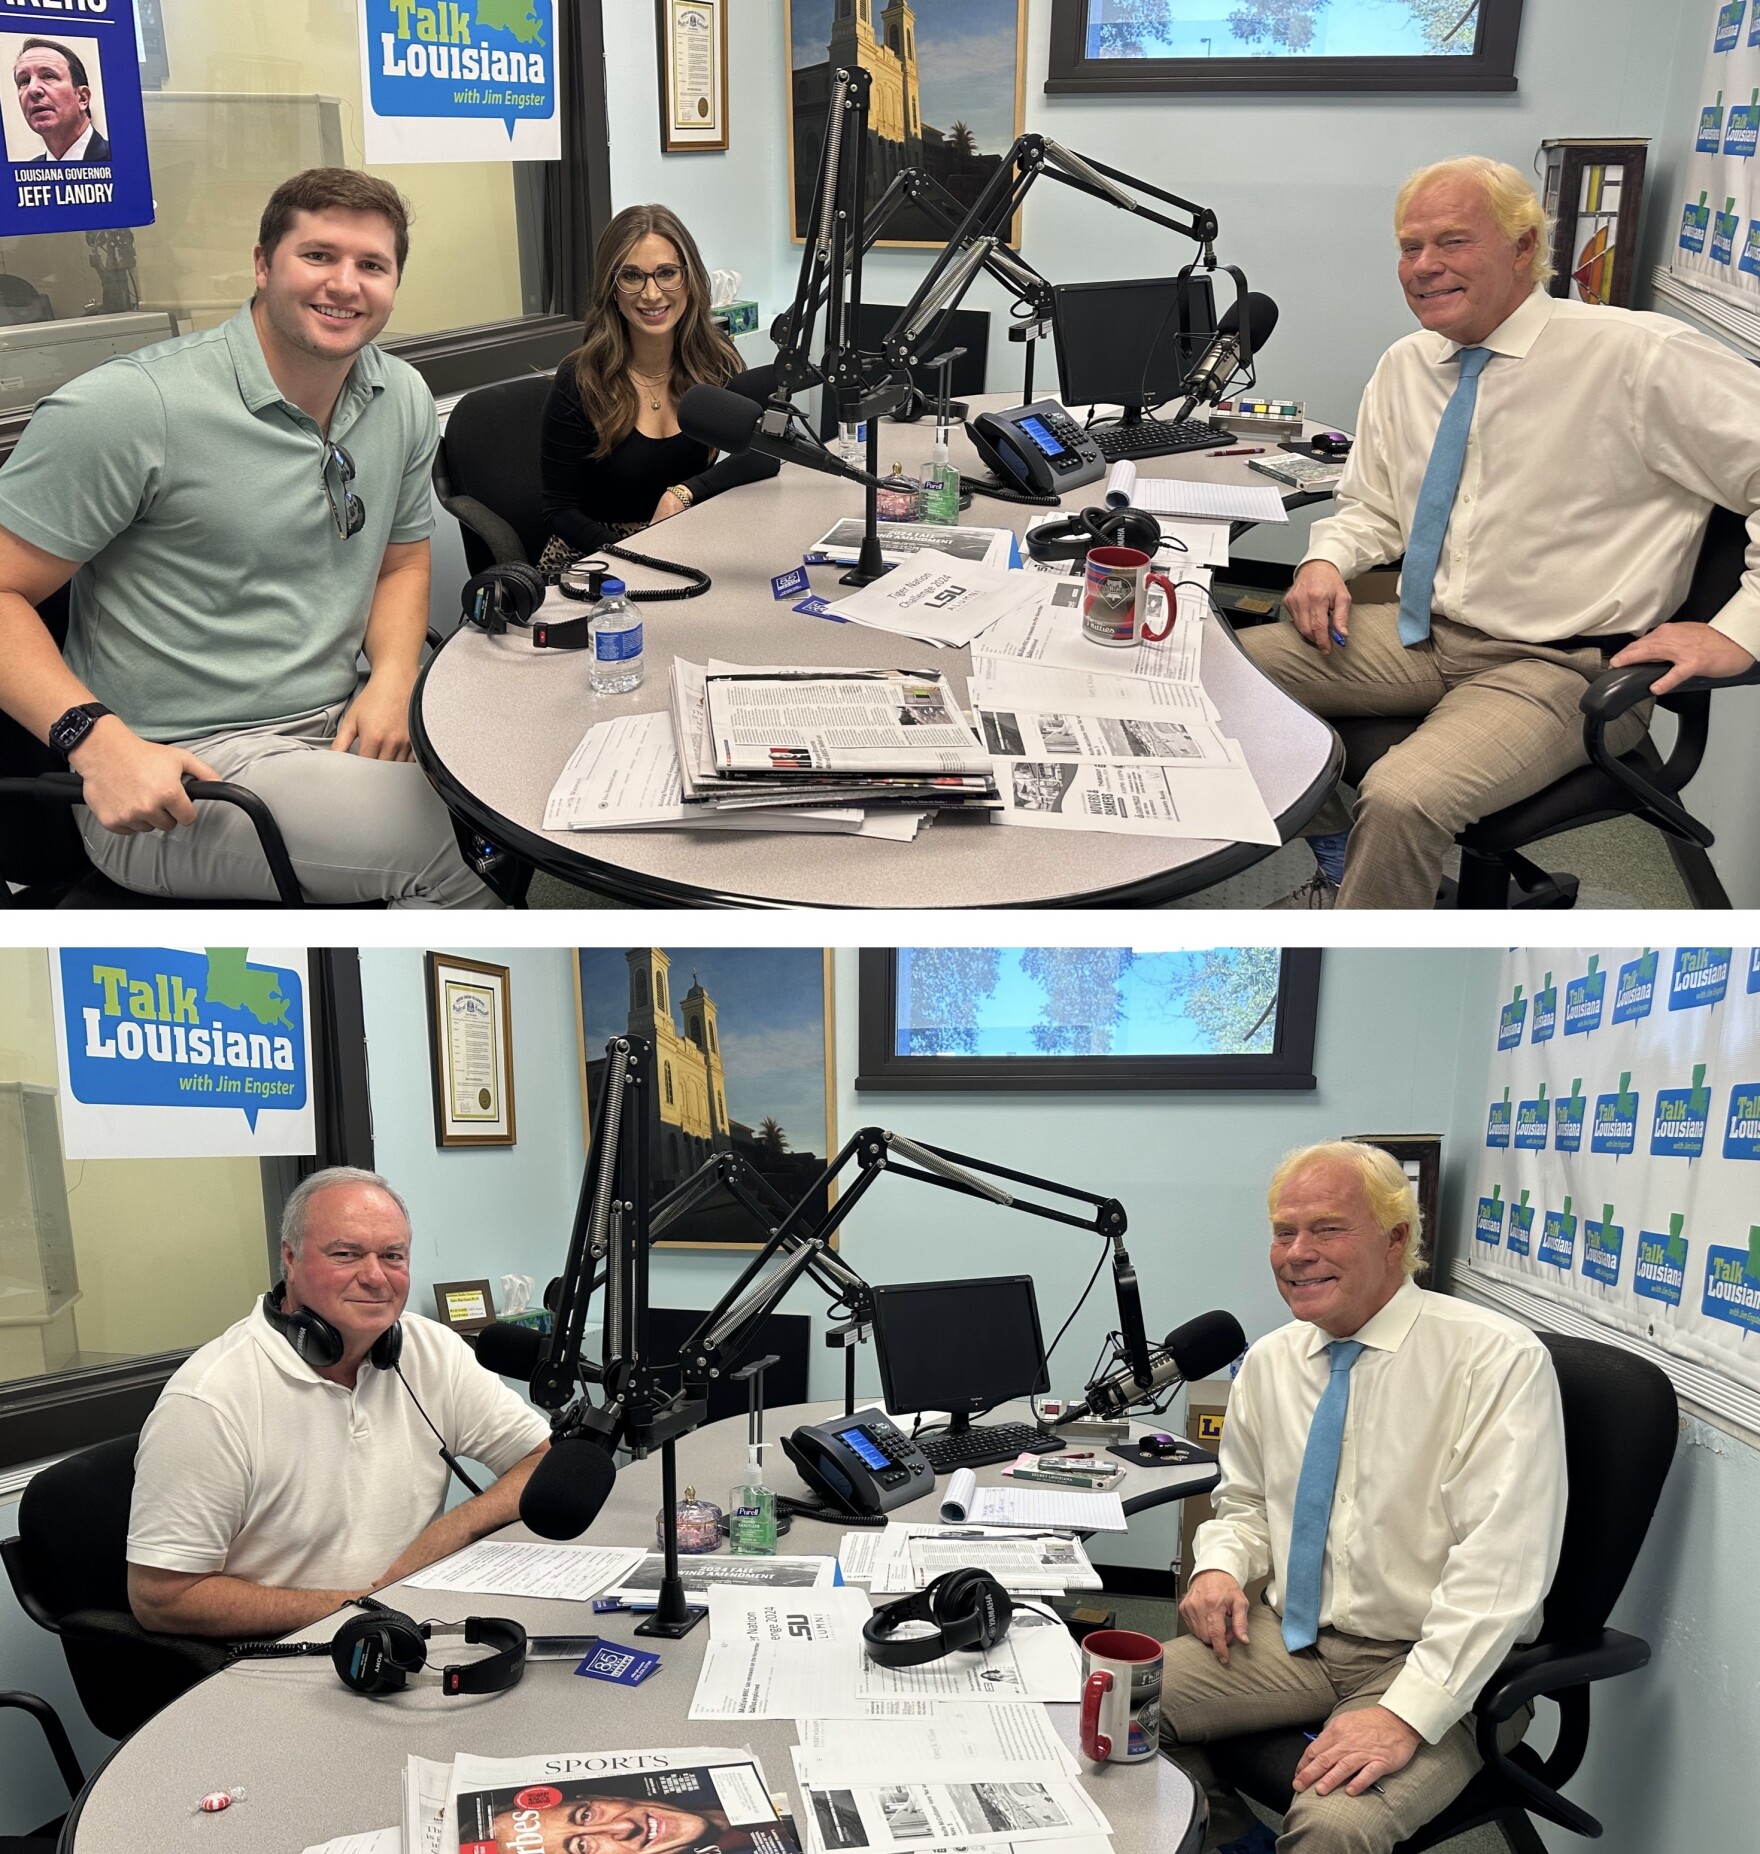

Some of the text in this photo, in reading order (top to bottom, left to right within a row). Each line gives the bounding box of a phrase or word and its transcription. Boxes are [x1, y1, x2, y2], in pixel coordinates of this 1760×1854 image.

[390, 0, 470, 44] Talk
[381, 33, 545, 84] Louisiana
[454, 89, 545, 109] with Jim Engster
[15, 167, 111, 182] LOUISIANA GOVERNOR
[18, 183, 113, 207] JEFF LANDRY
[894, 535, 954, 545] AMENDMENT
[887, 571, 933, 600] Tiger Nation
[899, 574, 952, 609] Challenge 2024
[924, 585, 967, 609] LSU
[947, 590, 983, 611] ALUMNI
[1087, 794, 1103, 815] MOVERS
[1101, 793, 1118, 816] SHAKERS
[1681, 948, 1708, 973] Talk
[1622, 971, 1638, 991] Talk
[1673, 963, 1727, 992] Louisiana
[92, 964, 199, 1025] Talk
[1569, 988, 1584, 1006] Talk
[1616, 983, 1650, 1007] Louisiana
[1566, 998, 1600, 1020] Louisiana
[83, 1007, 295, 1071] Louisiana
[179, 1074, 295, 1098] with Jim Engster
[1521, 1108, 1536, 1122] Talk
[1599, 1103, 1615, 1123] Talk
[1660, 1100, 1687, 1121] Talk
[1516, 1120, 1546, 1136] Louisiana
[1594, 1119, 1632, 1137] Louisiana
[1654, 1117, 1703, 1138] Louisiana
[1477, 1215, 1500, 1233] Louisiana
[1543, 1232, 1573, 1254] Louisiana
[1587, 1230, 1600, 1248] Talk
[1585, 1244, 1617, 1270] Louisiana
[1641, 1242, 1665, 1265] Talk
[1636, 1258, 1681, 1286] Louisiana
[1714, 1257, 1744, 1284] Talk
[1708, 1275, 1760, 1310] Louisian
[739, 1507, 759, 1516] Purell
[709, 1571, 775, 1580] AMENDMENT
[764, 1606, 778, 1623] 2024
[985, 1593, 996, 1627] YAMAHA
[746, 1611, 758, 1635] Nation
[786, 1614, 813, 1641] SU
[814, 1613, 829, 1640] LUMNI
[374, 1652, 384, 1674] SONY
[594, 1654, 618, 1672] 85
[1140, 1669, 1161, 1685] Phill
[545, 1754, 669, 1775] SPORTS
[506, 1810, 545, 1854] rbes
